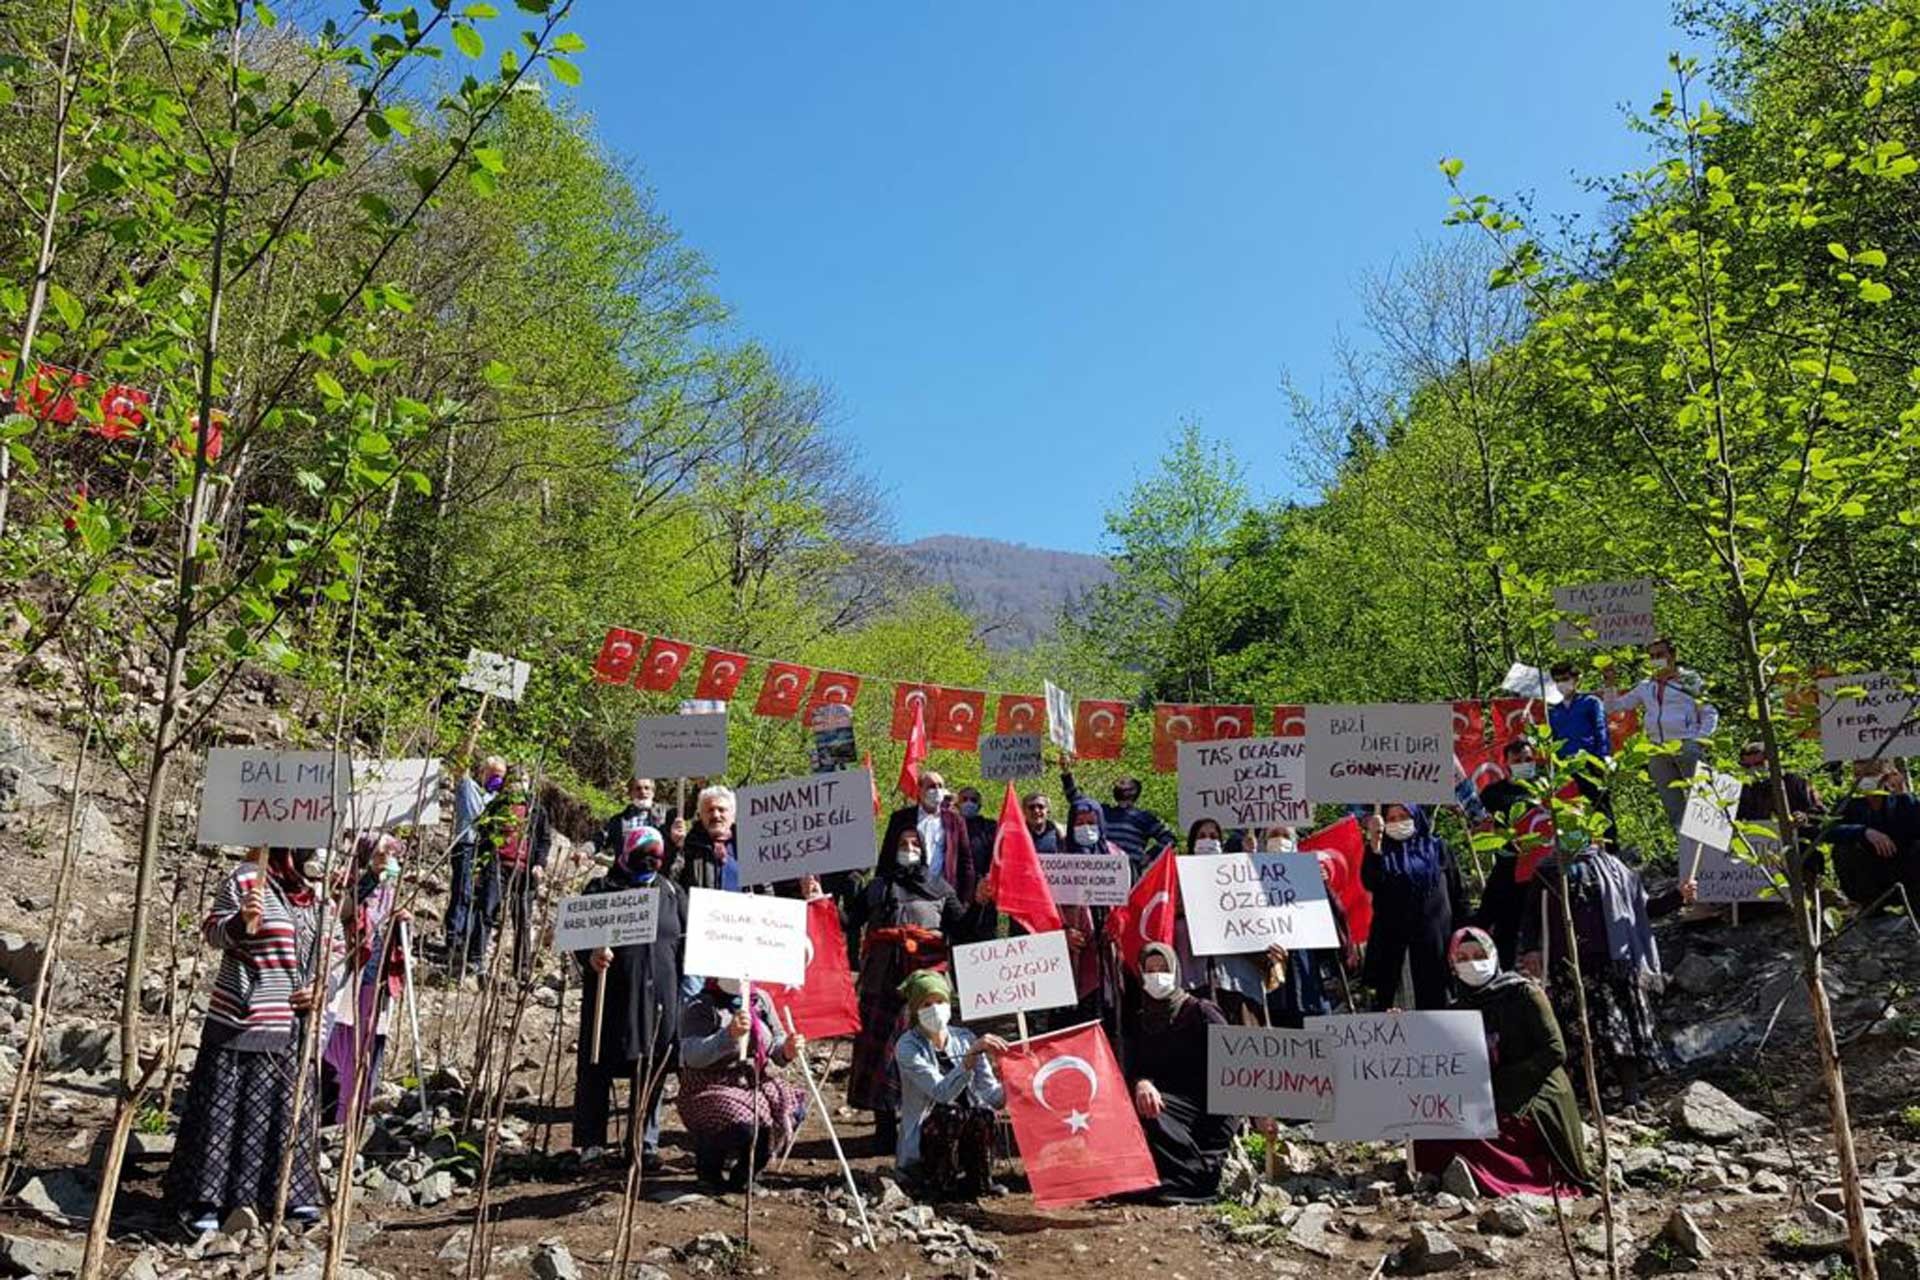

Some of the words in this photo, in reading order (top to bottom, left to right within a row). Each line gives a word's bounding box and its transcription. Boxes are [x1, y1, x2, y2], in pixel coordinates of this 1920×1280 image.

[1197, 746, 1233, 766] TAŞ
[240, 759, 287, 784] BAL
[1231, 799, 1310, 825] YATIRIM
[757, 840, 792, 863] KUŞ
[1089, 875, 1117, 887] KORUR
[1215, 860, 1291, 886] SULAR
[1219, 887, 1305, 912] ÖZGÜR
[589, 913, 616, 929] YAŞAR
[617, 909, 650, 927] KUŞLAR
[1223, 915, 1293, 939] AKSIN
[967, 940, 1031, 966] SULAR
[974, 981, 1037, 1009] AKSIN
[1219, 1066, 1335, 1098] DOKUNMA
